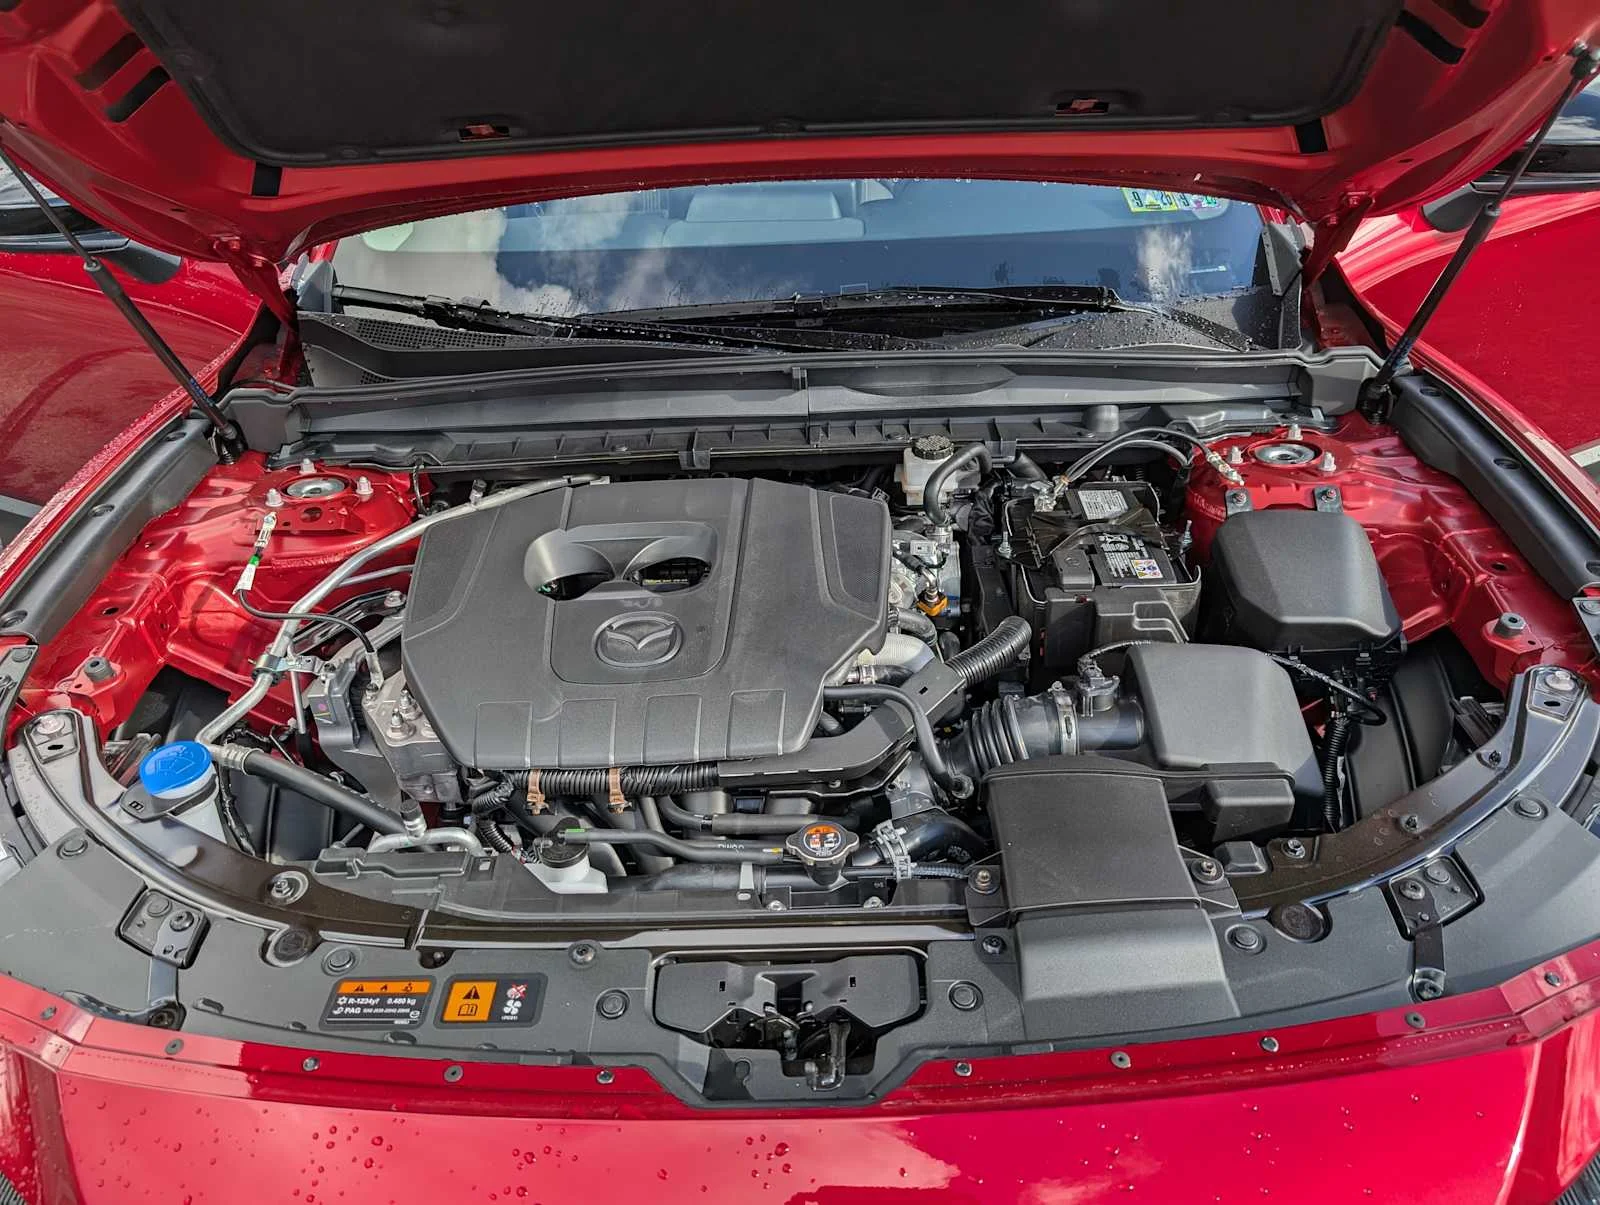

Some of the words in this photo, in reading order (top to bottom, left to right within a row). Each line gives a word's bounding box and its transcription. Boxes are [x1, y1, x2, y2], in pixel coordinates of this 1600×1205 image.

[1132, 191, 1144, 208] 9
[347, 997, 380, 1006] R-1234yf
[407, 997, 417, 1006] kg
[344, 1007, 361, 1015] PAG
